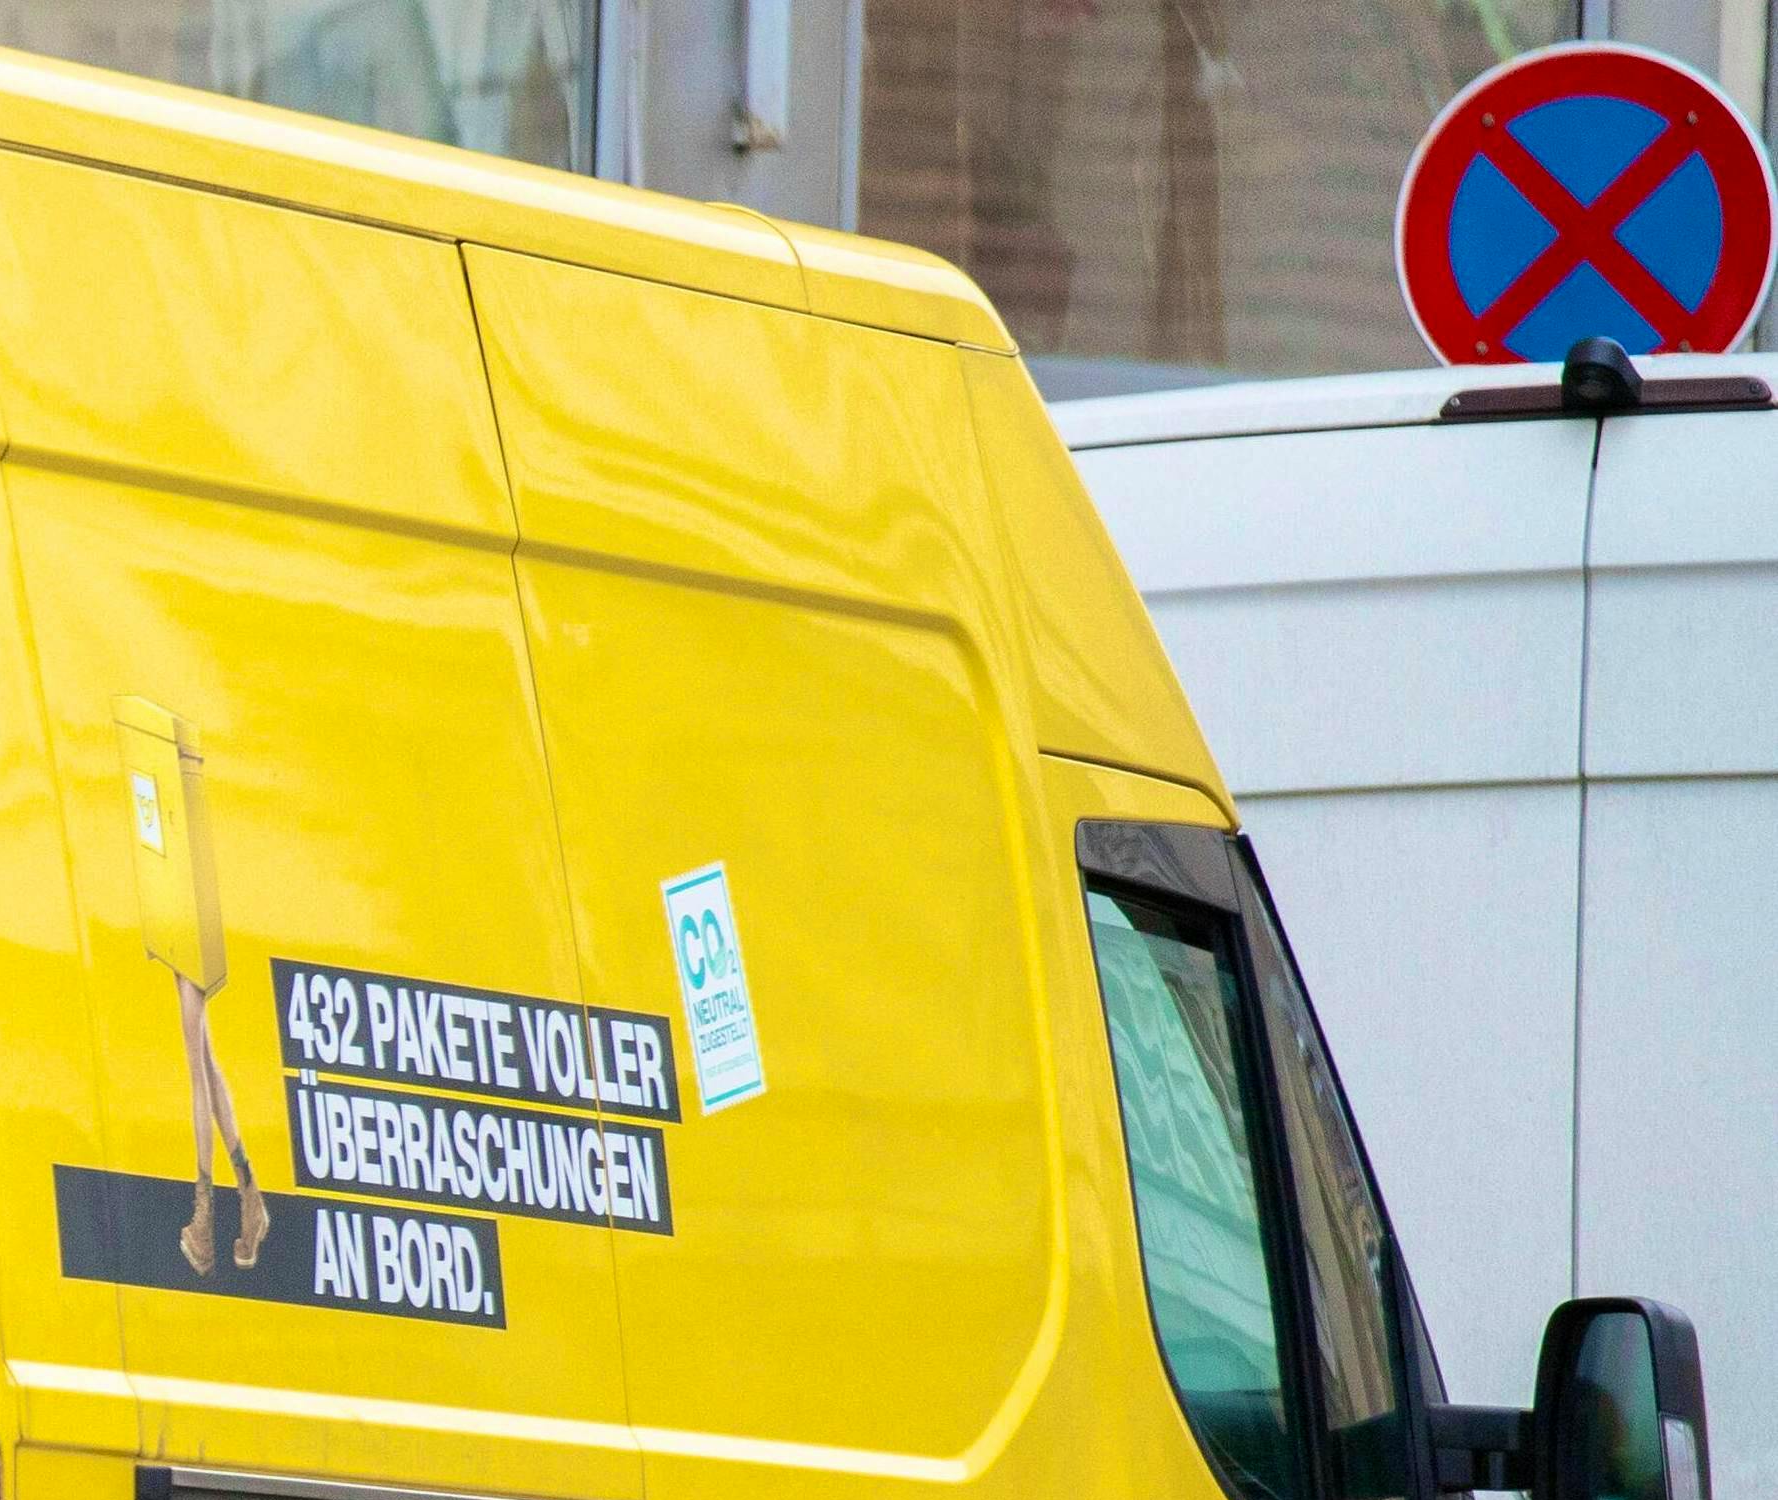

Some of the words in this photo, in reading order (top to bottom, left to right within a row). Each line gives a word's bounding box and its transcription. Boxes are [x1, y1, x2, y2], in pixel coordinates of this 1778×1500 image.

[288, 973, 364, 1066] 432
[366, 982, 519, 1090] PAKETE
[521, 1008, 669, 1111] VOLLER
[693, 985, 744, 1029] NEUTRAL
[297, 1069, 660, 1223] ÜBERRASCHUNGEN
[313, 1208, 368, 1301] AN
[375, 1214, 496, 1316] BORD.
